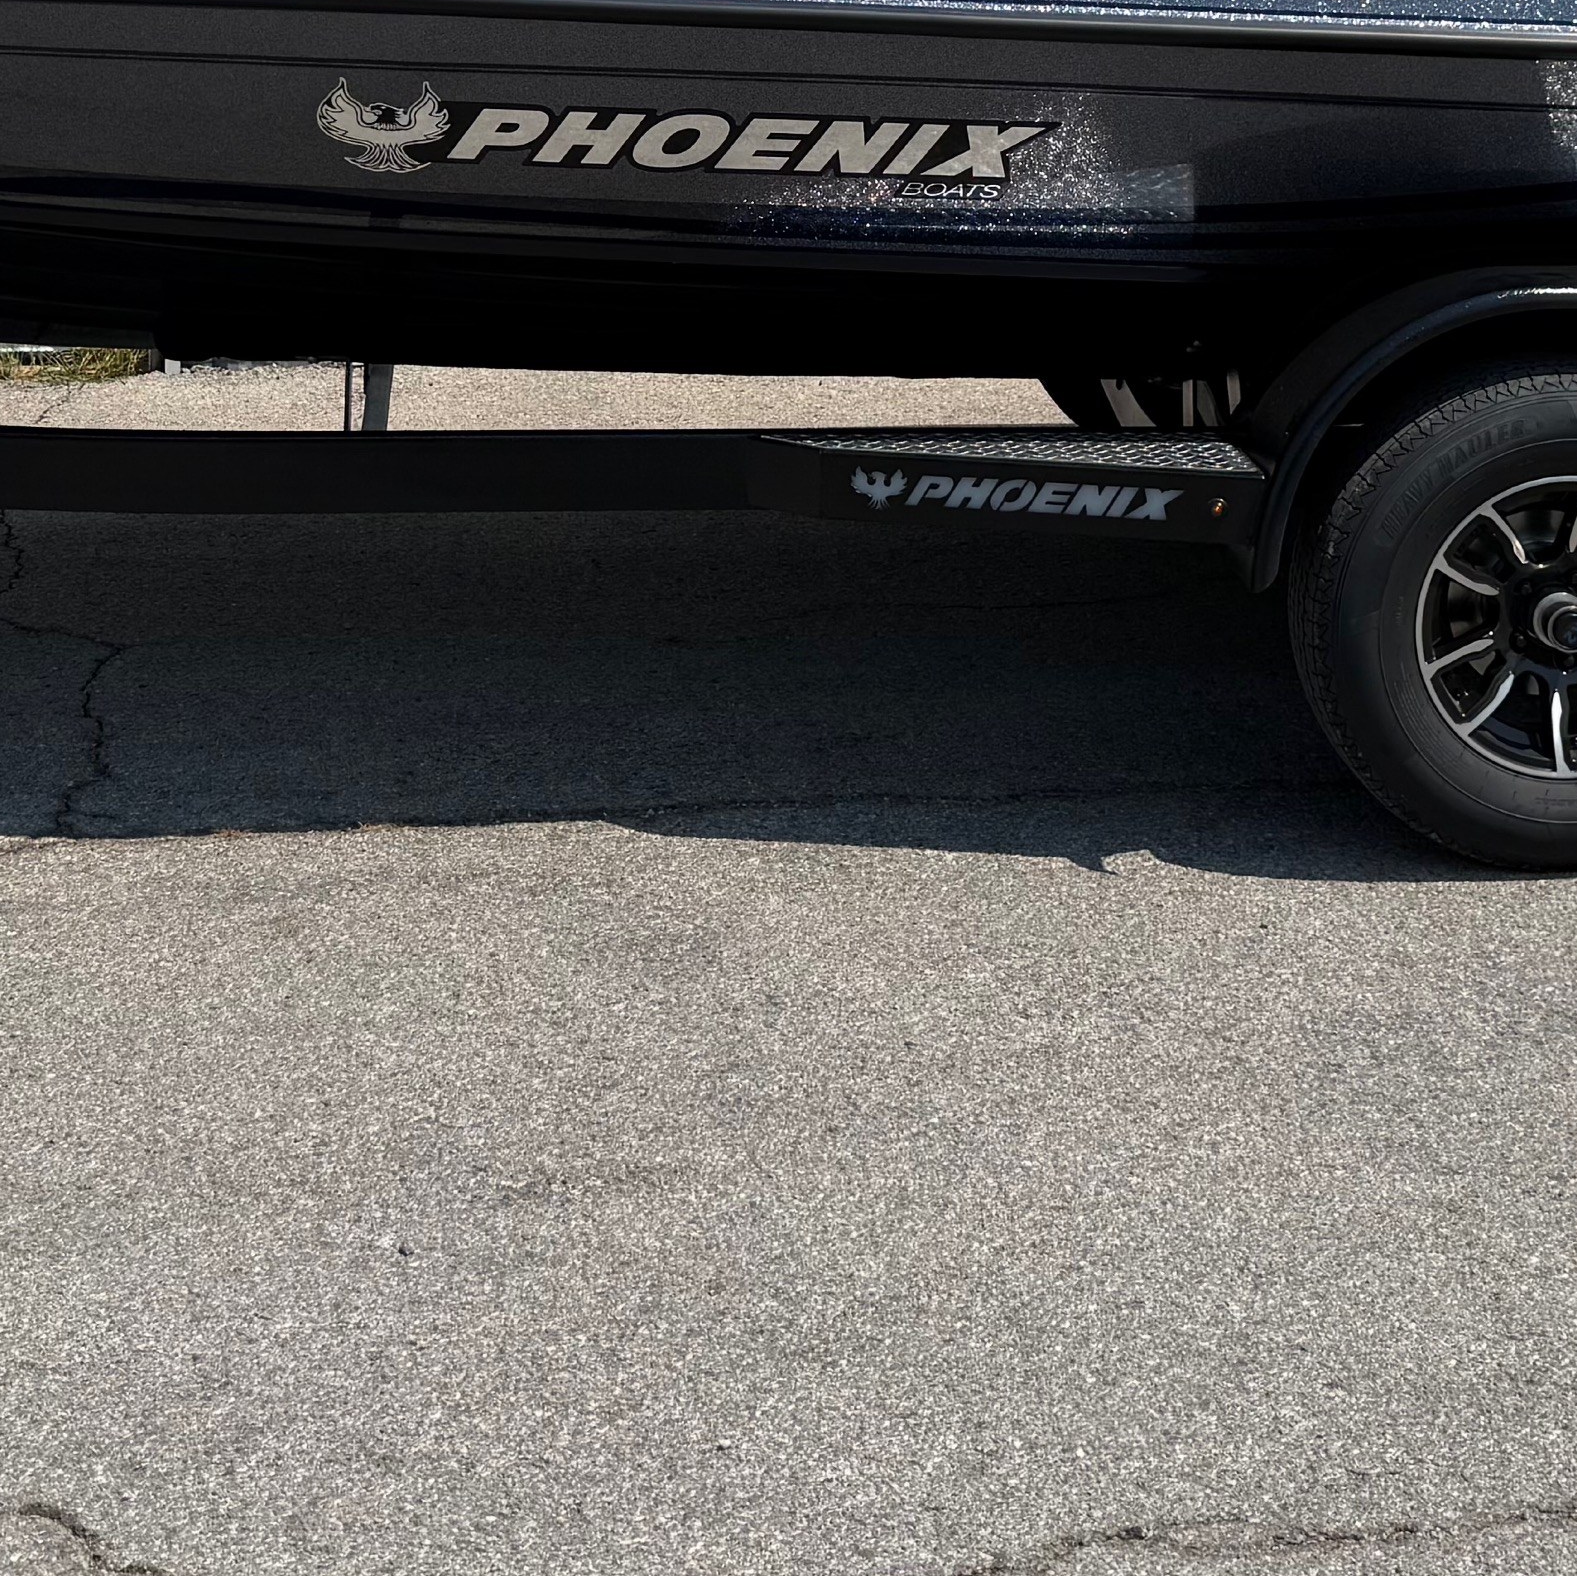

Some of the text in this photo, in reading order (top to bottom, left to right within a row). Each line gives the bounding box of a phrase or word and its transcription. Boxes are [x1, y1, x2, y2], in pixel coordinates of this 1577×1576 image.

[446, 107, 1047, 179] PHOENIX
[901, 182, 1003, 200] BOATS
[904, 475, 1185, 521] PHOENIX
